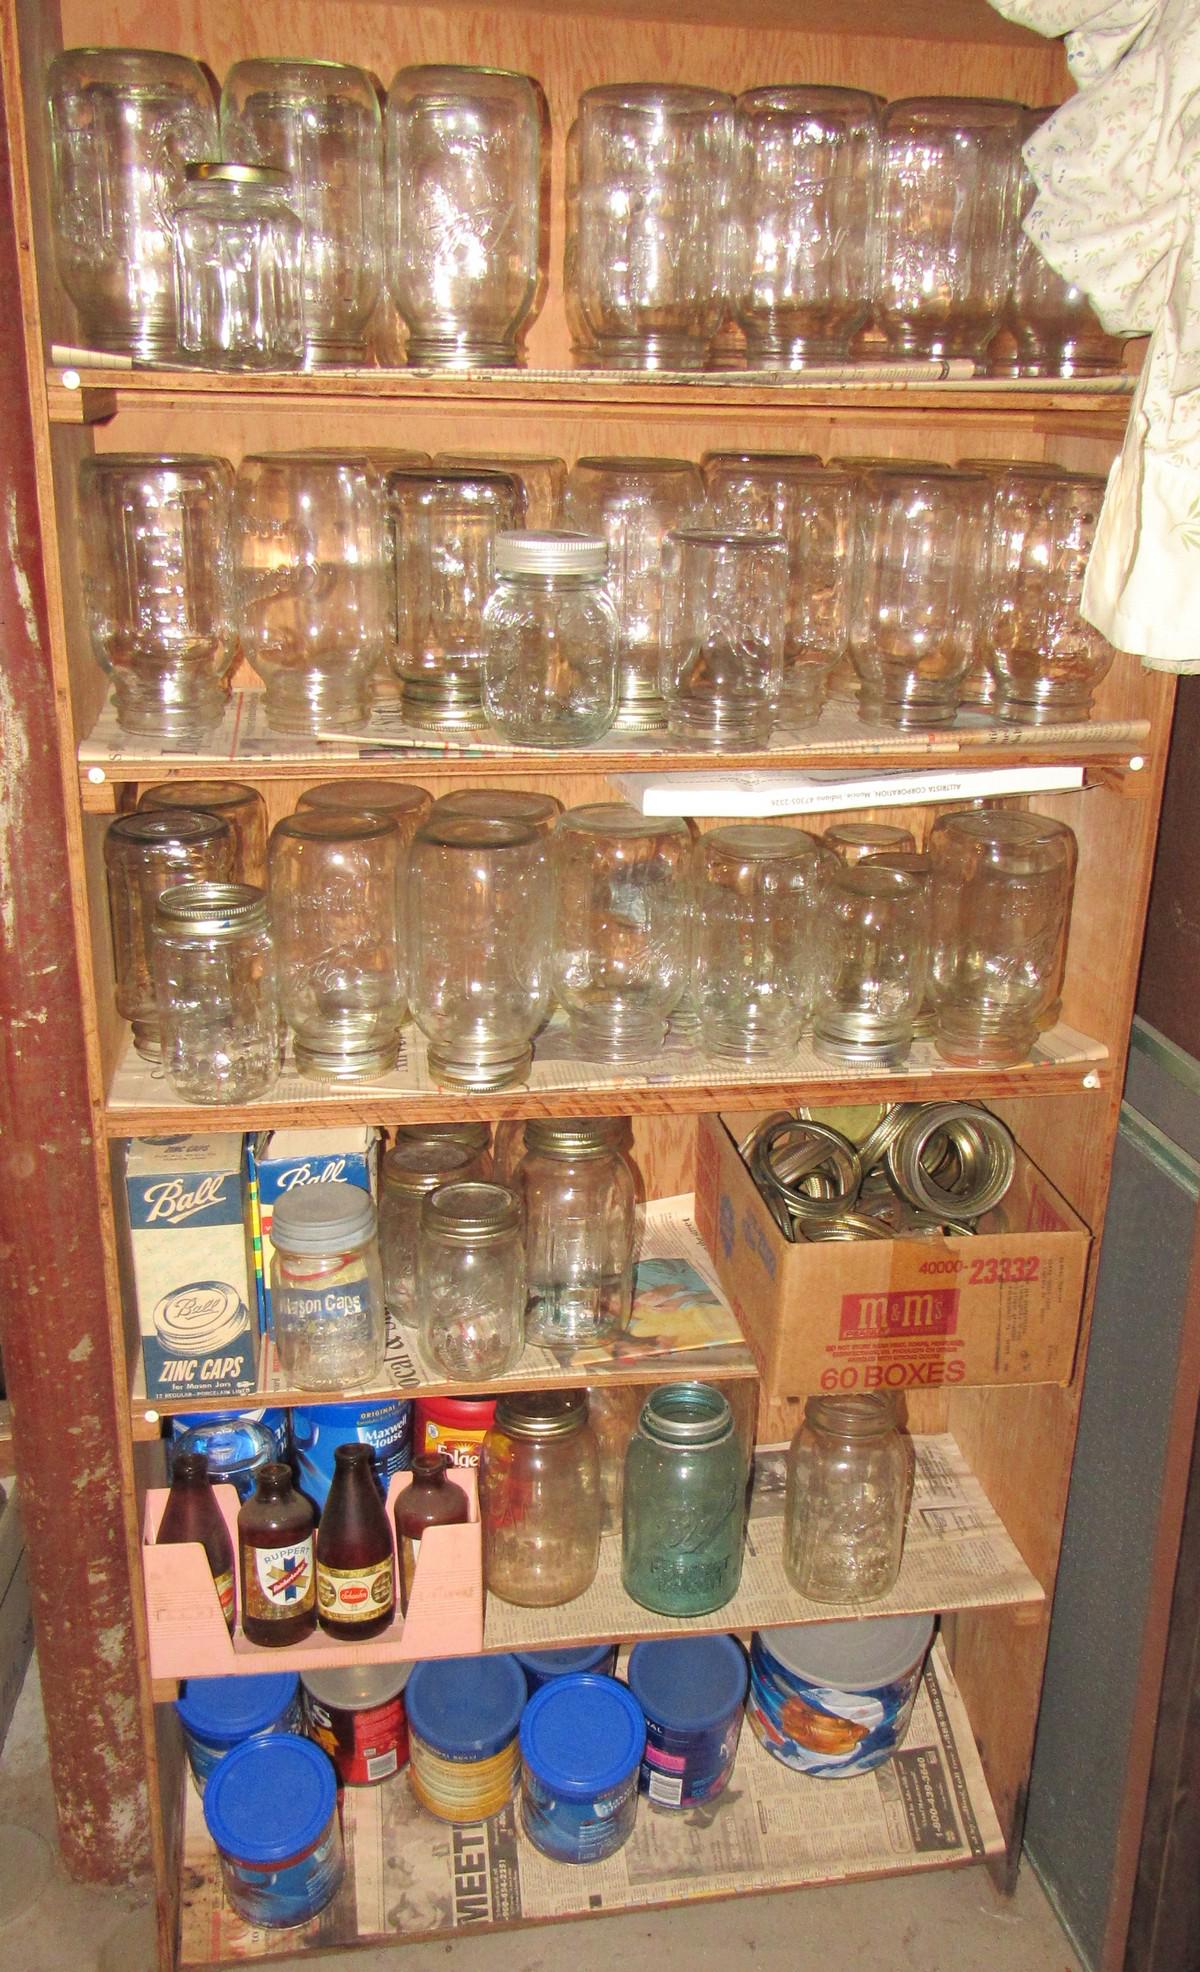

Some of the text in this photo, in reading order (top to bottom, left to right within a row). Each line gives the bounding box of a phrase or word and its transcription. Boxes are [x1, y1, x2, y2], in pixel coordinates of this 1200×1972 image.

[928, 783, 961, 793] ALLTRISTA
[143, 1176, 227, 1224] Ball
[174, 1297, 221, 1320] Ball
[325, 1293, 362, 1316] Caps
[158, 1360, 198, 1382] ZINC
[200, 1356, 245, 1381] CAPS
[820, 1360, 966, 1391] 60 BOXES
[172, 1380, 232, 1391] for Mason Jars
[365, 1414, 408, 1441] Maxwell
[370, 1429, 403, 1450] House
[264, 1546, 310, 1564] RUPPERT
